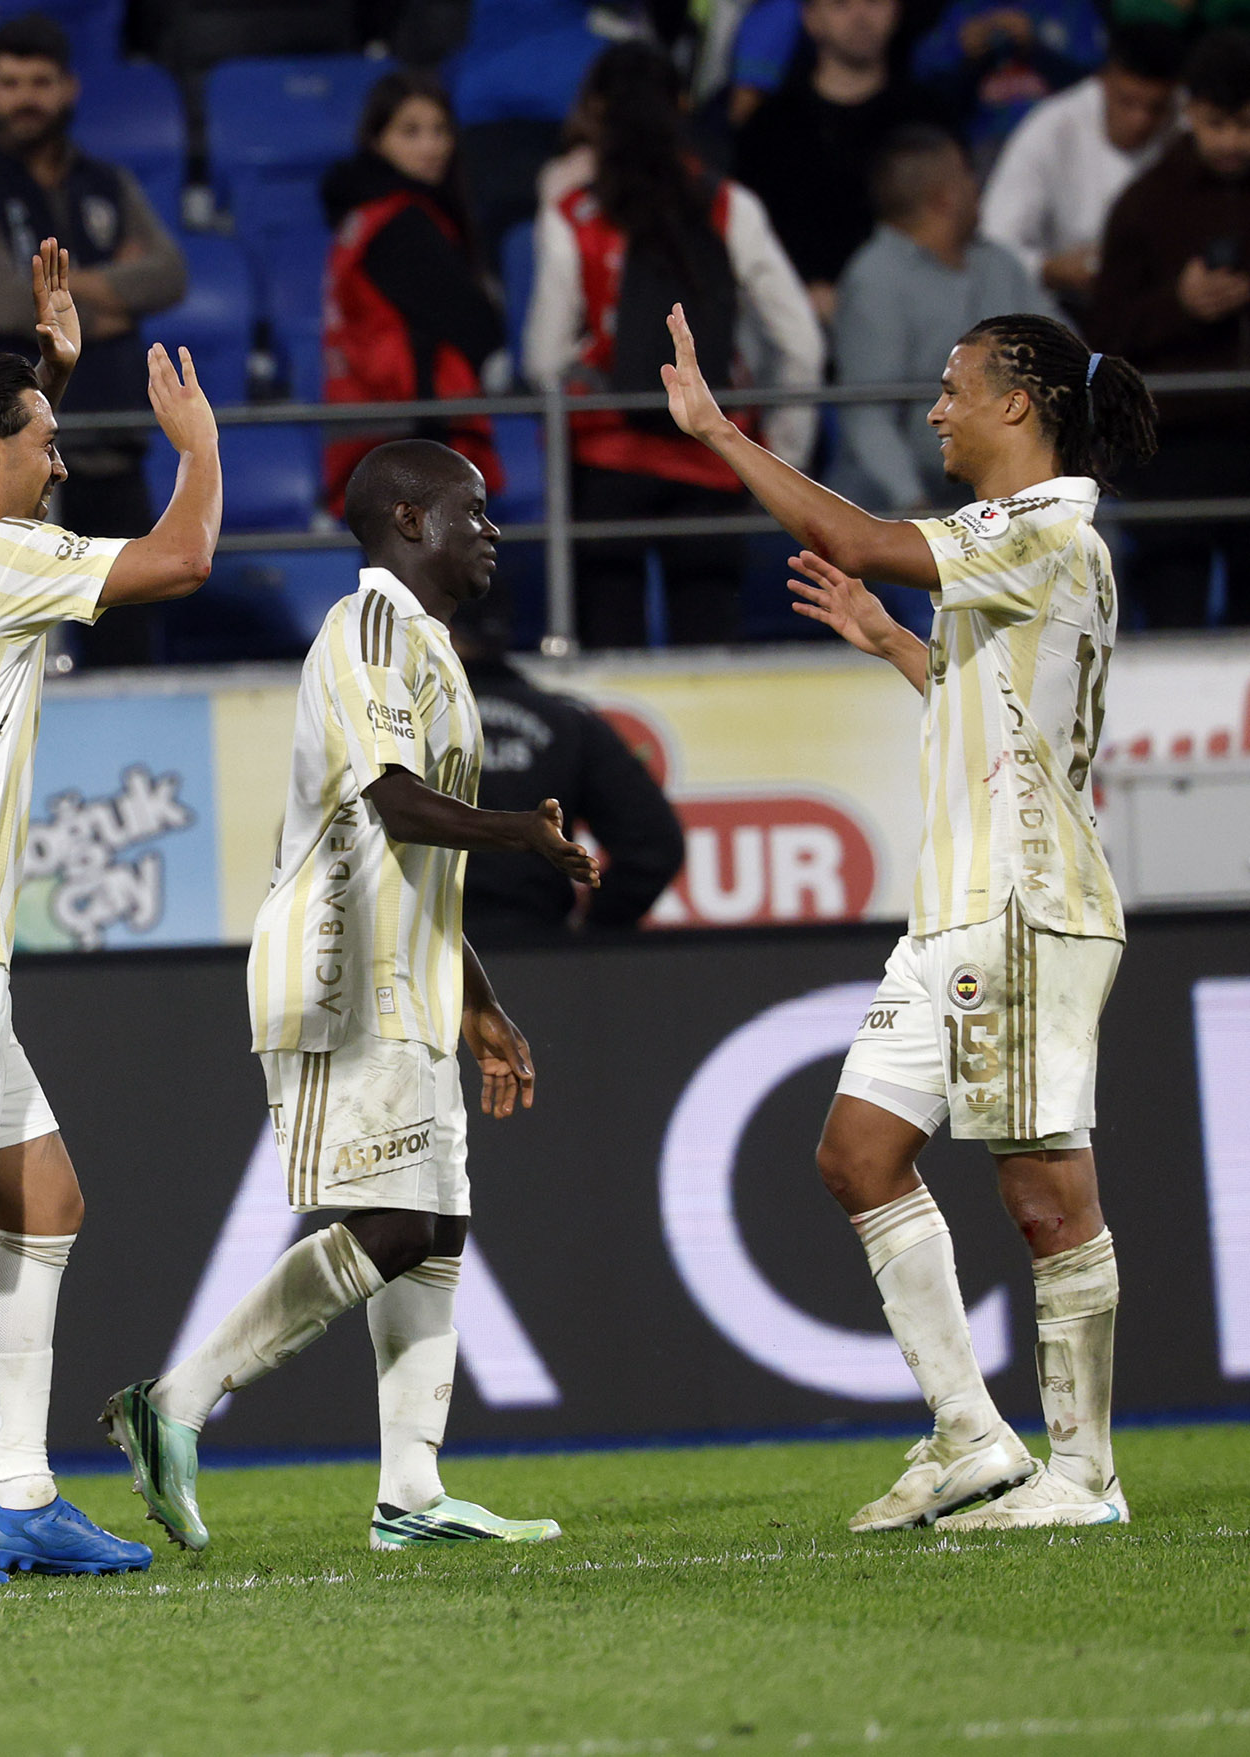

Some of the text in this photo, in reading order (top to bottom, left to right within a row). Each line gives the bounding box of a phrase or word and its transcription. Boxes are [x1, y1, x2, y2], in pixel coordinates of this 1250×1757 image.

[315, 798, 359, 1017] ACIBADEM
[943, 1013, 999, 1084] 15
[332, 1128, 431, 1175] Asperox
